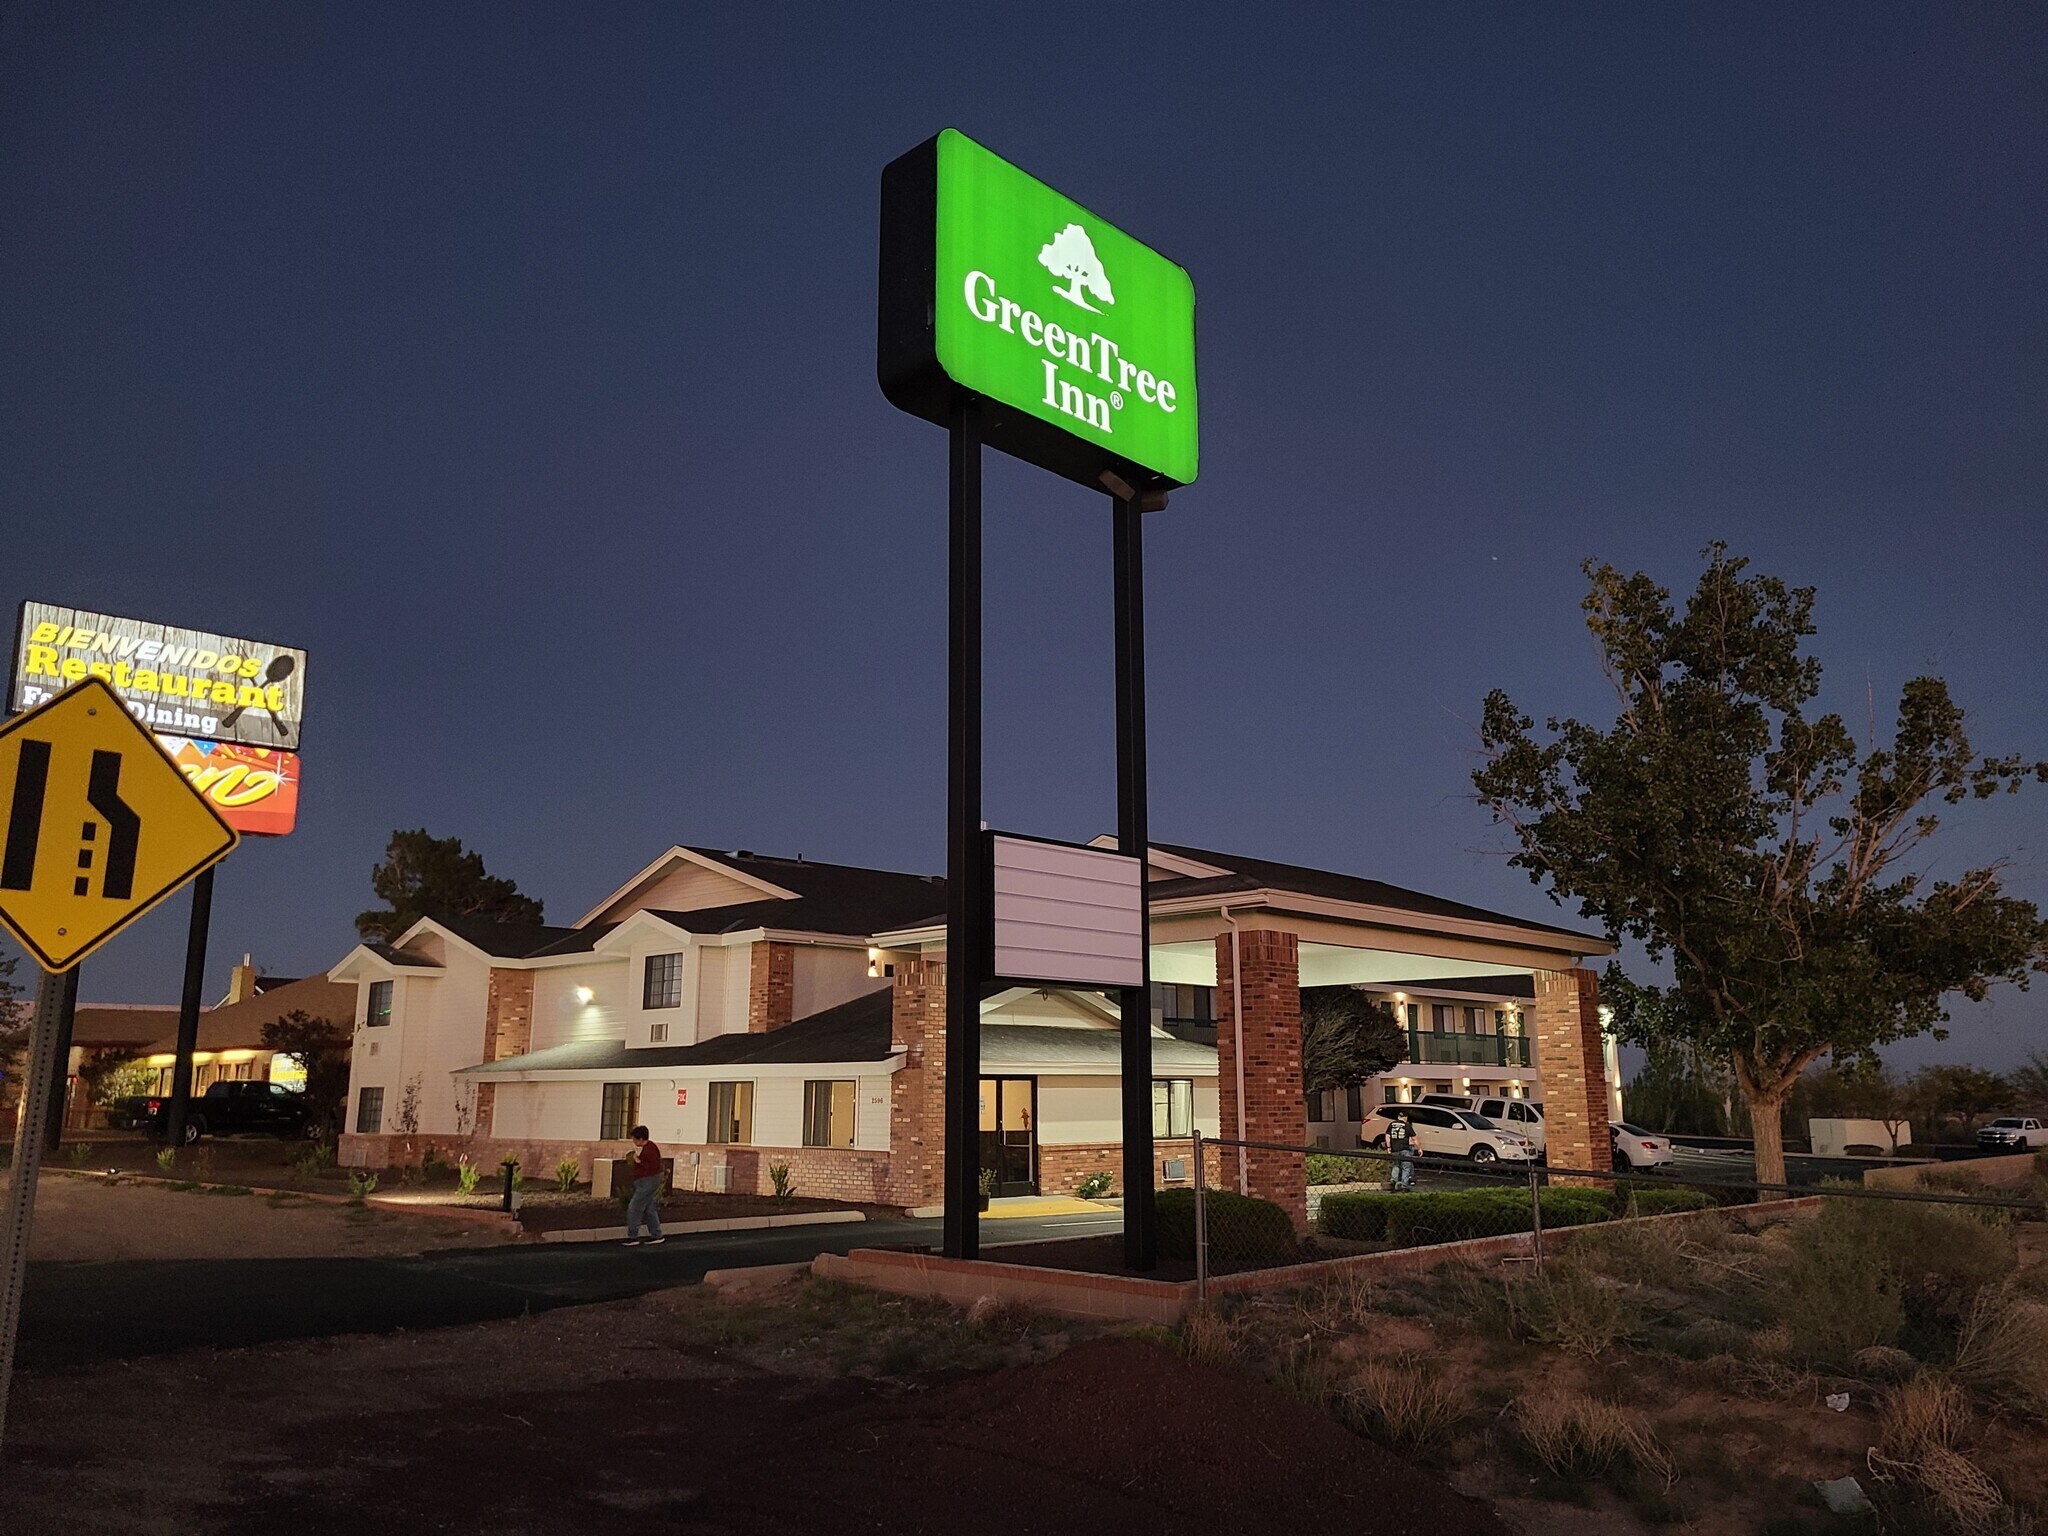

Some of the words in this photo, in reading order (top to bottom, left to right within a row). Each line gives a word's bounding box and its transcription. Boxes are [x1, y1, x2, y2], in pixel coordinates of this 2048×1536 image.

[964, 270, 1177, 412] GreenTree
[25, 645, 285, 711] Restaurant
[30, 622, 262, 678] BIENVENIDOS
[130, 702, 218, 733] Dining
